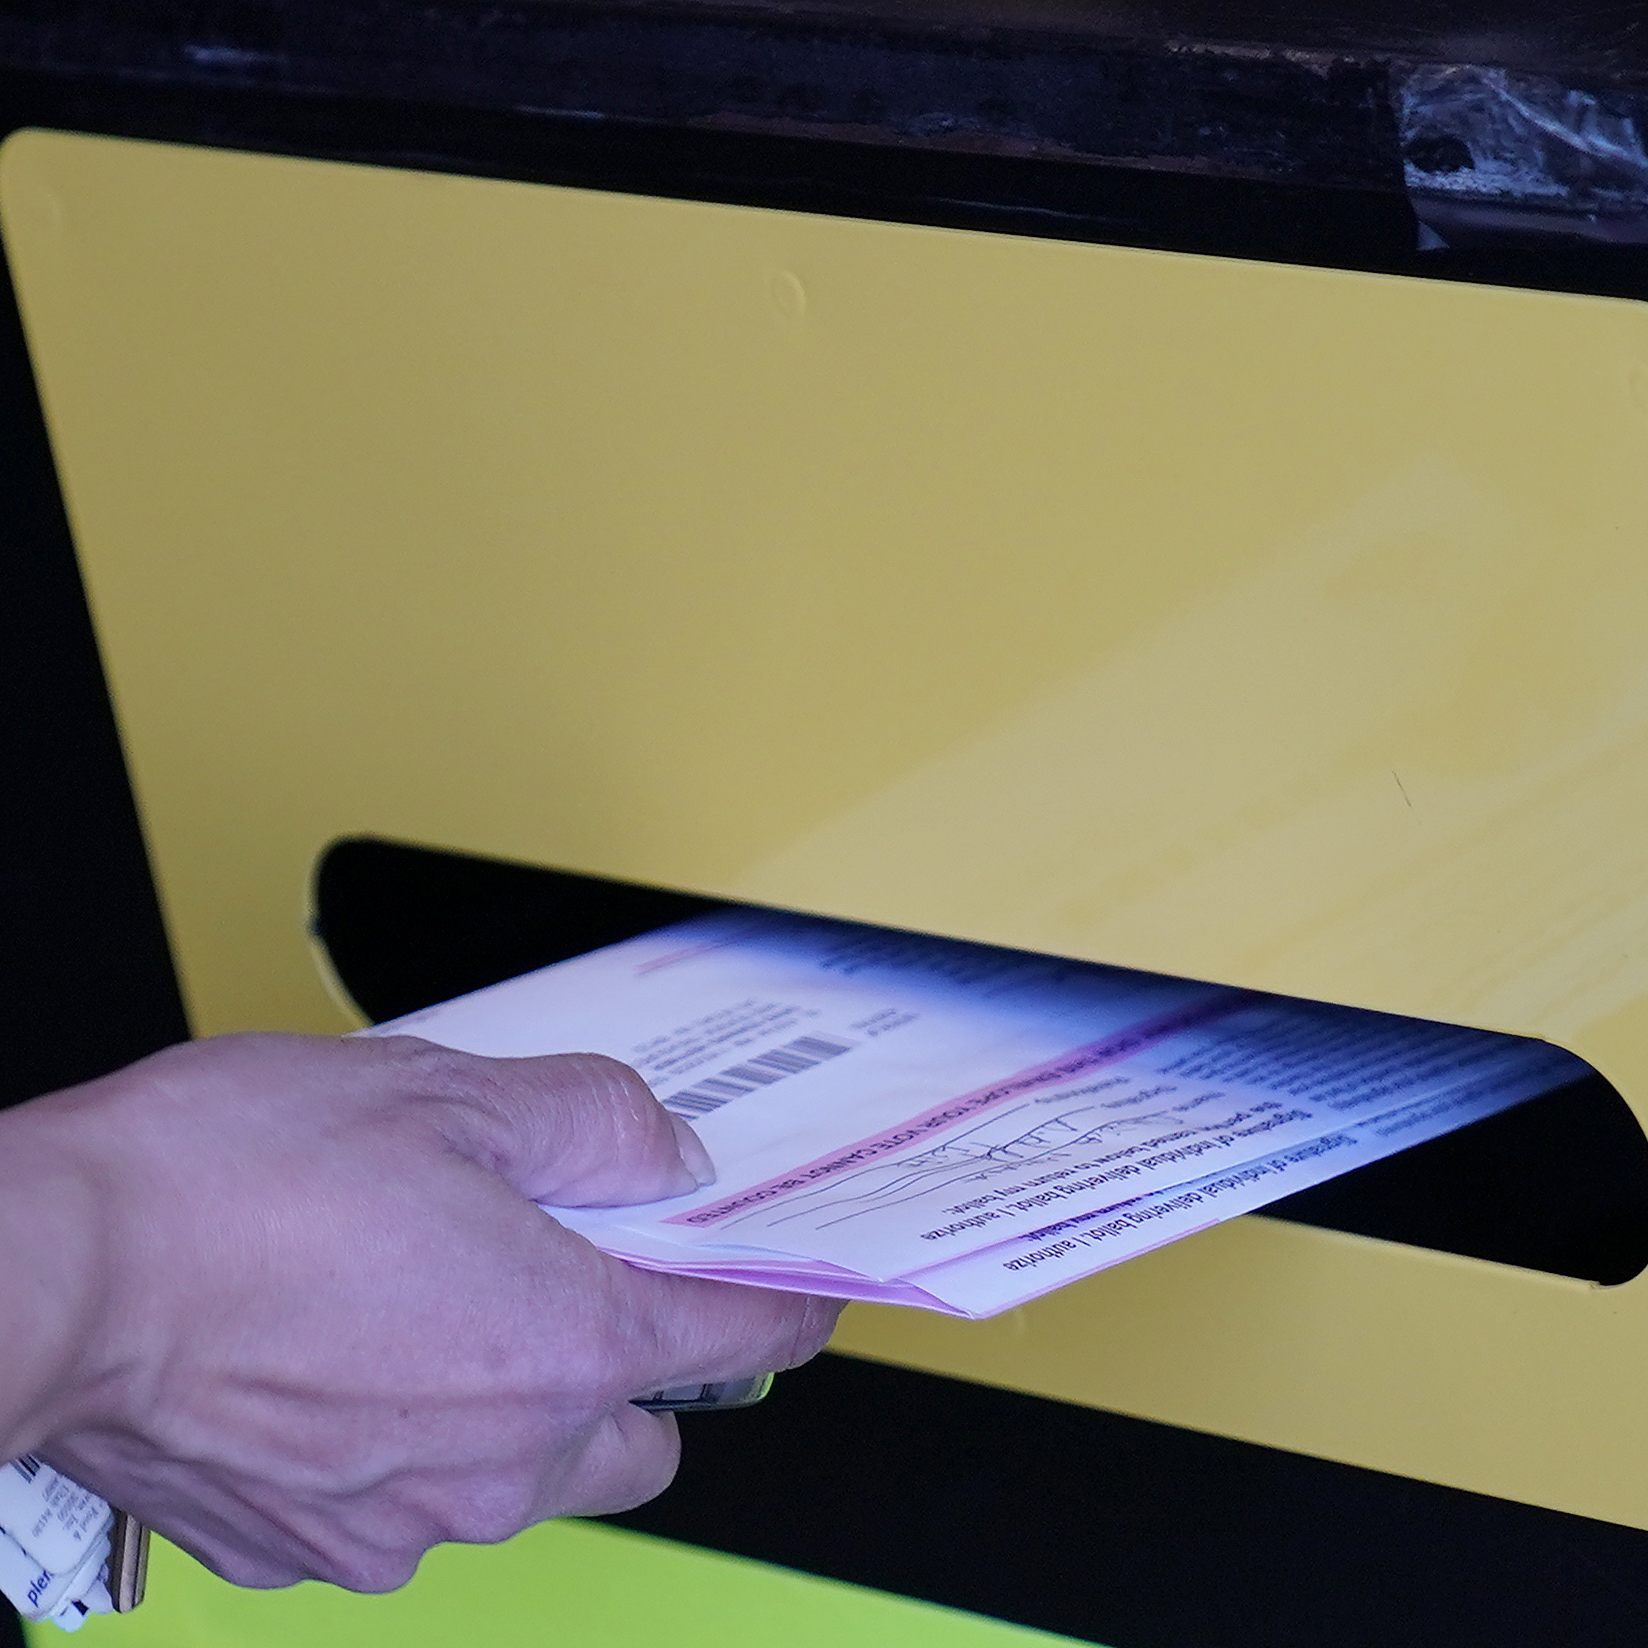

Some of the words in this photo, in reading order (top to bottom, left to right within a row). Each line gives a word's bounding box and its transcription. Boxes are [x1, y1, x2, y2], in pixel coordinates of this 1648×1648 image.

[870, 1128, 926, 1149] VOTE
[1212, 1134, 1239, 1145] of
[801, 1147, 878, 1177] CANNOT
[1138, 1140, 1222, 1169] individual
[993, 1184, 1027, 1197] my
[1023, 1168, 1078, 1187] return
[1054, 1164, 1144, 1194] delivering
[1198, 1165, 1274, 1196] individual
[1006, 1191, 1066, 1212] ballot.
[1122, 1191, 1206, 1223] delivering
[920, 1211, 1004, 1241] authorize
[1079, 1219, 1136, 1242] ballot.
[1002, 1240, 1079, 1272] authorize
